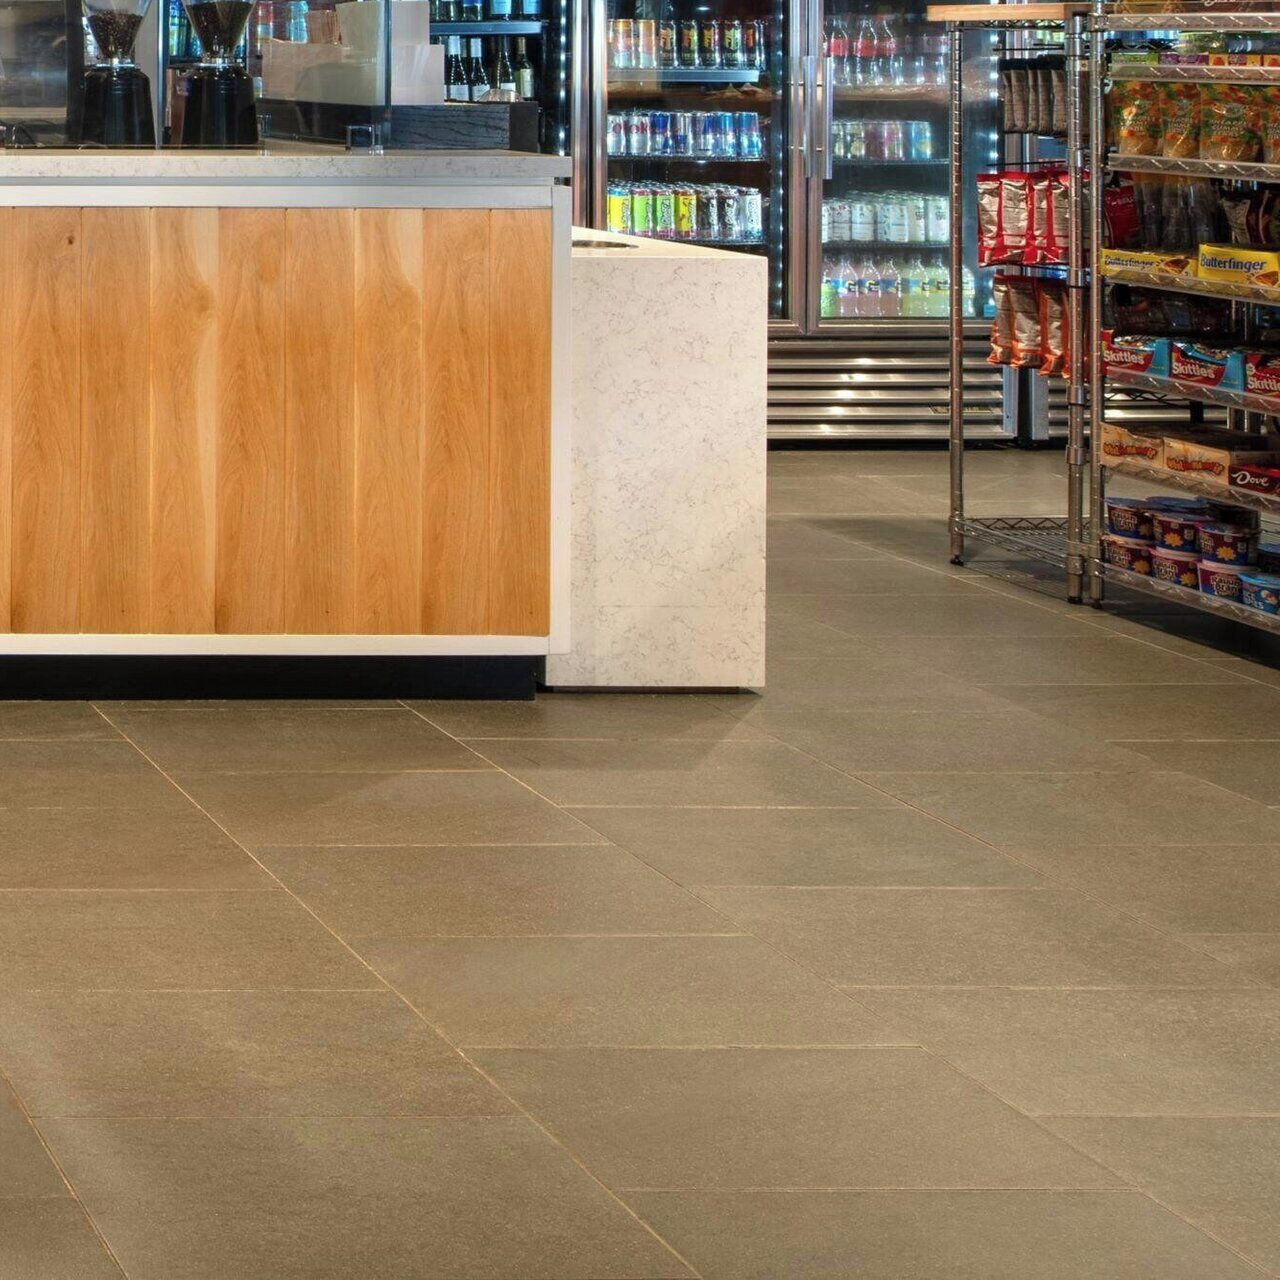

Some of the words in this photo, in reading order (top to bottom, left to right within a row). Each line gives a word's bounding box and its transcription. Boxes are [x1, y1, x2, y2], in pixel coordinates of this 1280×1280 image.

[1200, 253, 1267, 271] Butterfinger
[1104, 350, 1144, 365] Skittles
[1172, 361, 1215, 379] Skittles
[1231, 471, 1269, 486] Dove
